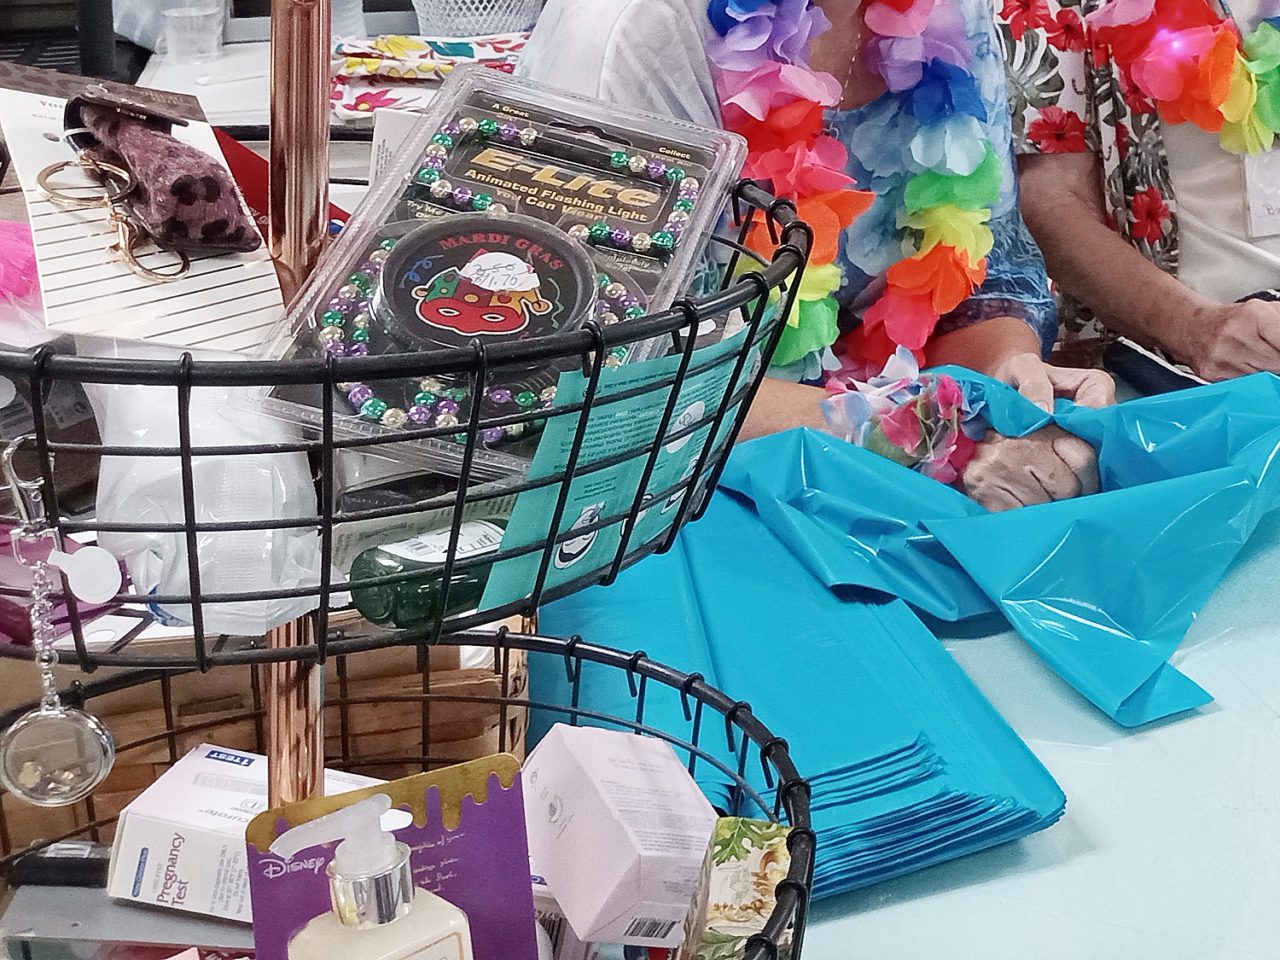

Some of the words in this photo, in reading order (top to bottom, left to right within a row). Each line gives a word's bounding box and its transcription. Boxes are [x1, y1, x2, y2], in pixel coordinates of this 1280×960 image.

[502, 105, 530, 118] Great
[658, 147, 691, 160] Collect
[464, 169, 539, 195] Animated
[541, 190, 606, 214] Flashing
[608, 205, 648, 222] Light
[525, 196, 556, 211] Can
[438, 233, 511, 250] MARDI
[515, 238, 563, 271] GRAS
[156, 832, 185, 903] Pregnancy
[172, 881, 188, 906] Test
